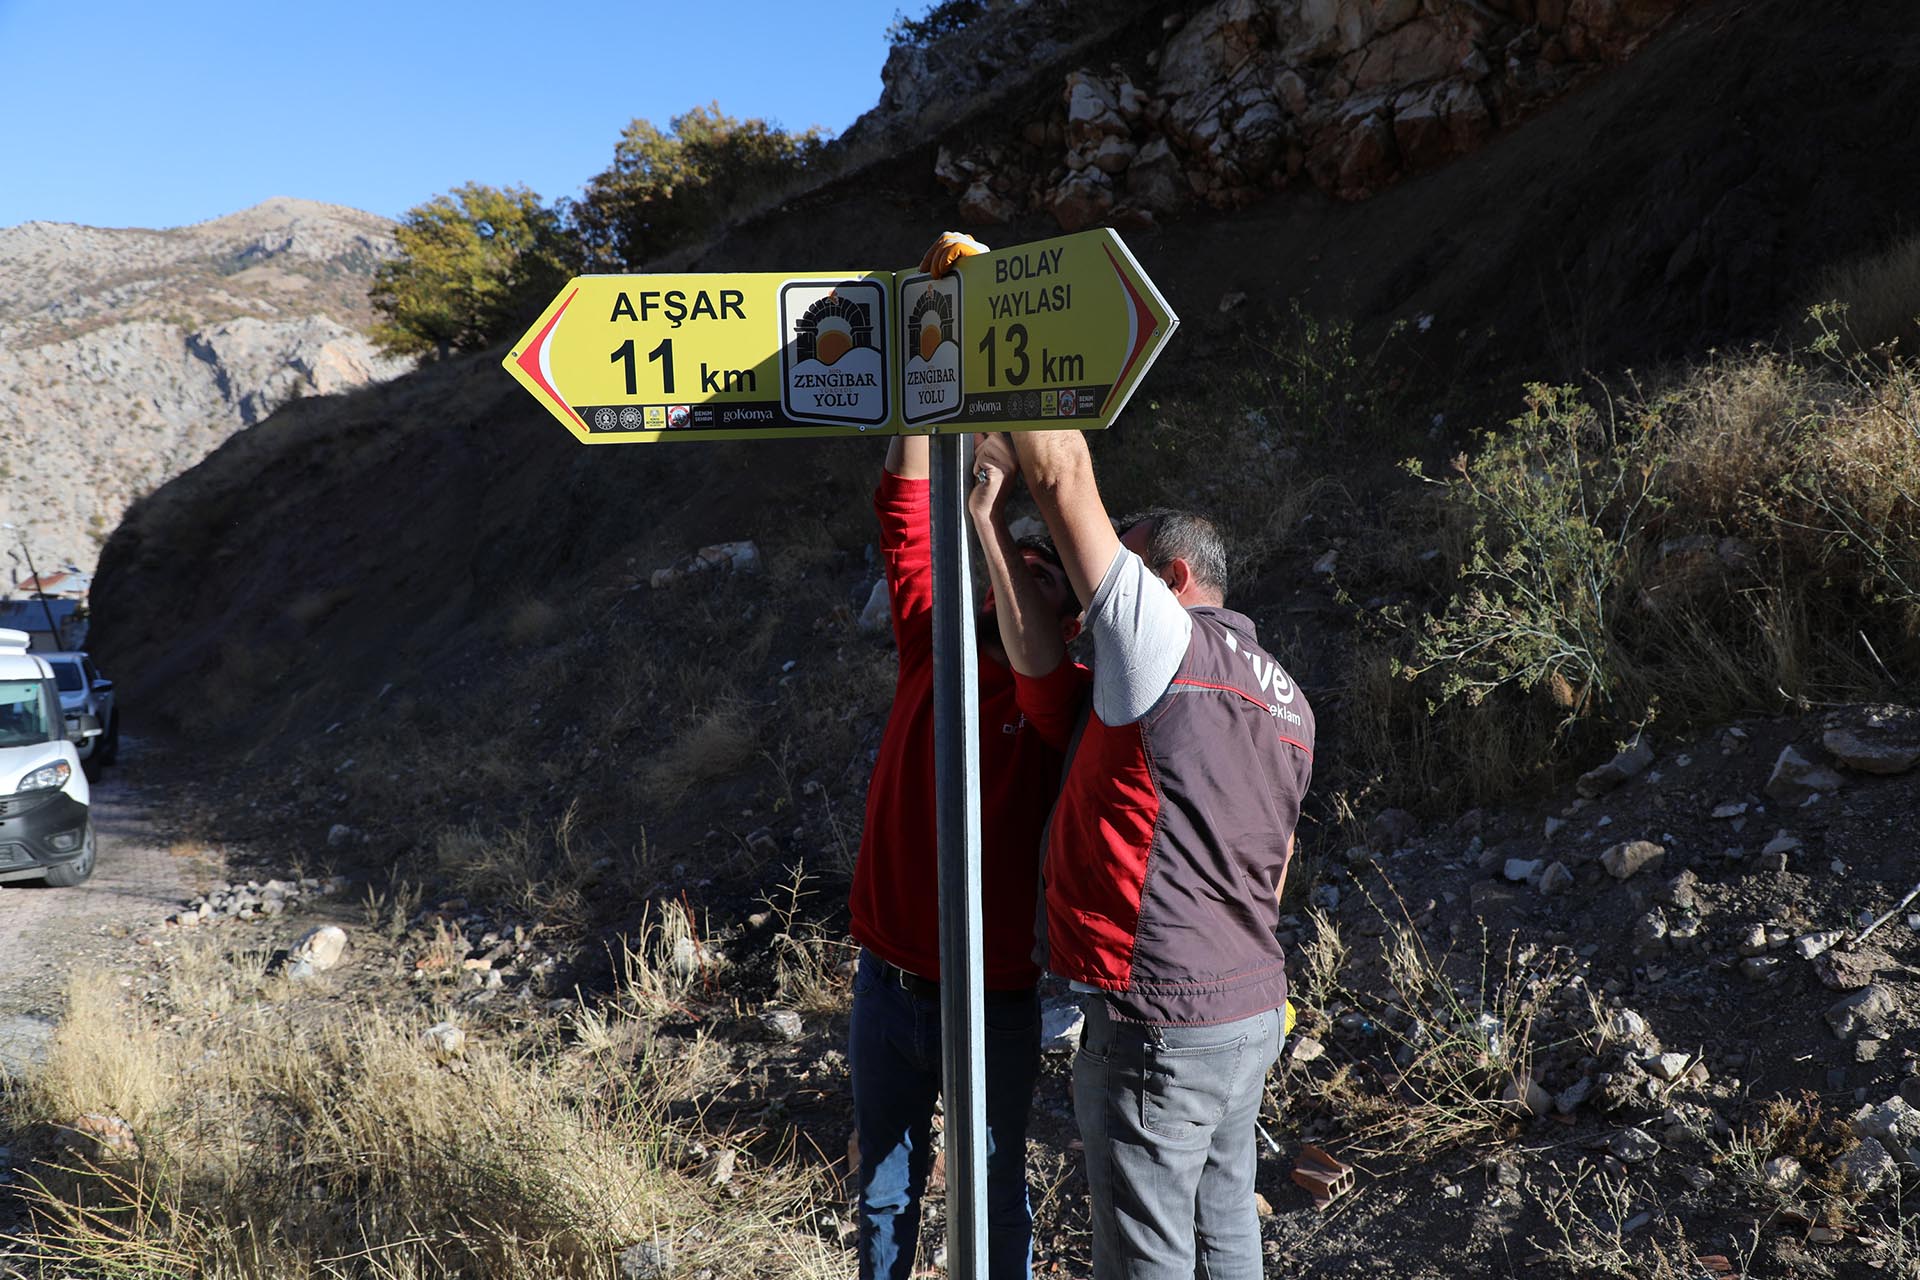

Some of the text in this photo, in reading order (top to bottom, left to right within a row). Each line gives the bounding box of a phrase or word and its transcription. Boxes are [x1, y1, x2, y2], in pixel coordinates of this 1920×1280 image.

[995, 248, 1064, 284] BOLAY
[610, 289, 746, 328] AFŞAR
[988, 284, 1072, 320] YAYLASI
[610, 338, 756, 395] 11 km
[979, 323, 1084, 387] 13 km
[813, 392, 859, 407] YOLU
[918, 390, 945, 404] YOLU
[968, 400, 1002, 415] goKonya
[723, 408, 774, 423] goKonya
